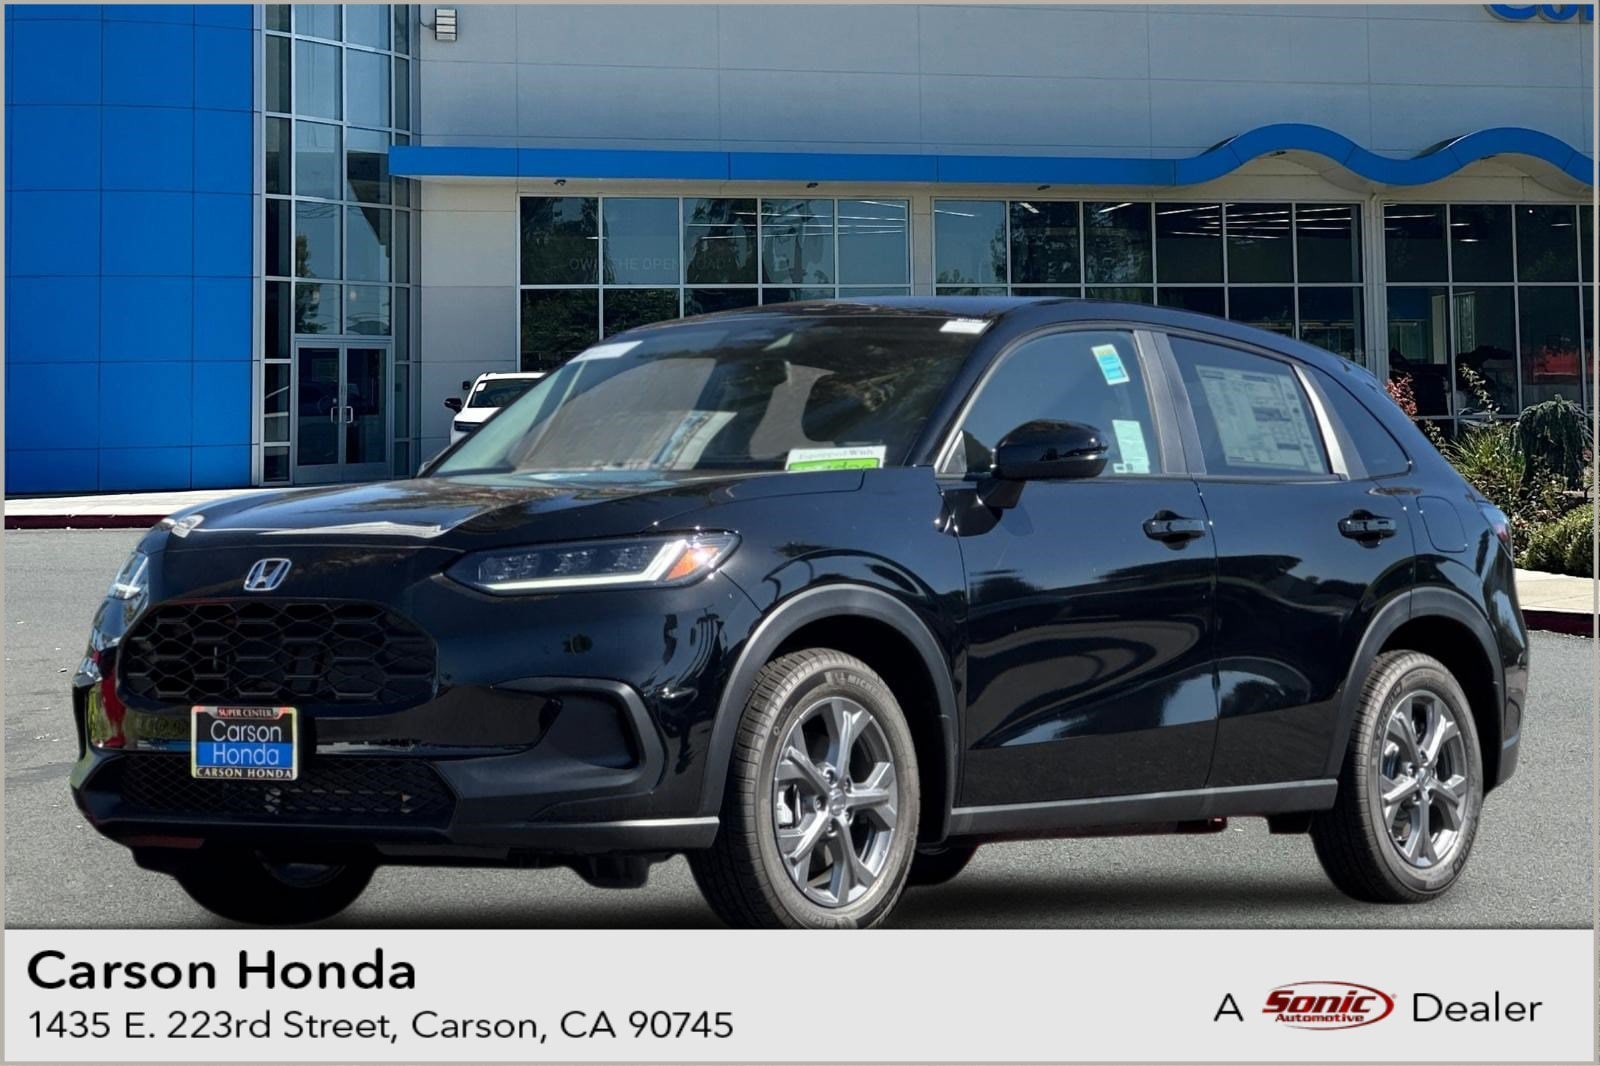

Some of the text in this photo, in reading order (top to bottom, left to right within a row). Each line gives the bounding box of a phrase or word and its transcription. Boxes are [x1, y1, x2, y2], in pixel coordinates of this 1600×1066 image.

[218, 708, 273, 718] SUPER CENTER
[210, 720, 282, 743] Carson
[213, 743, 280, 766] Honda
[196, 767, 293, 779] CARSON HONDA
